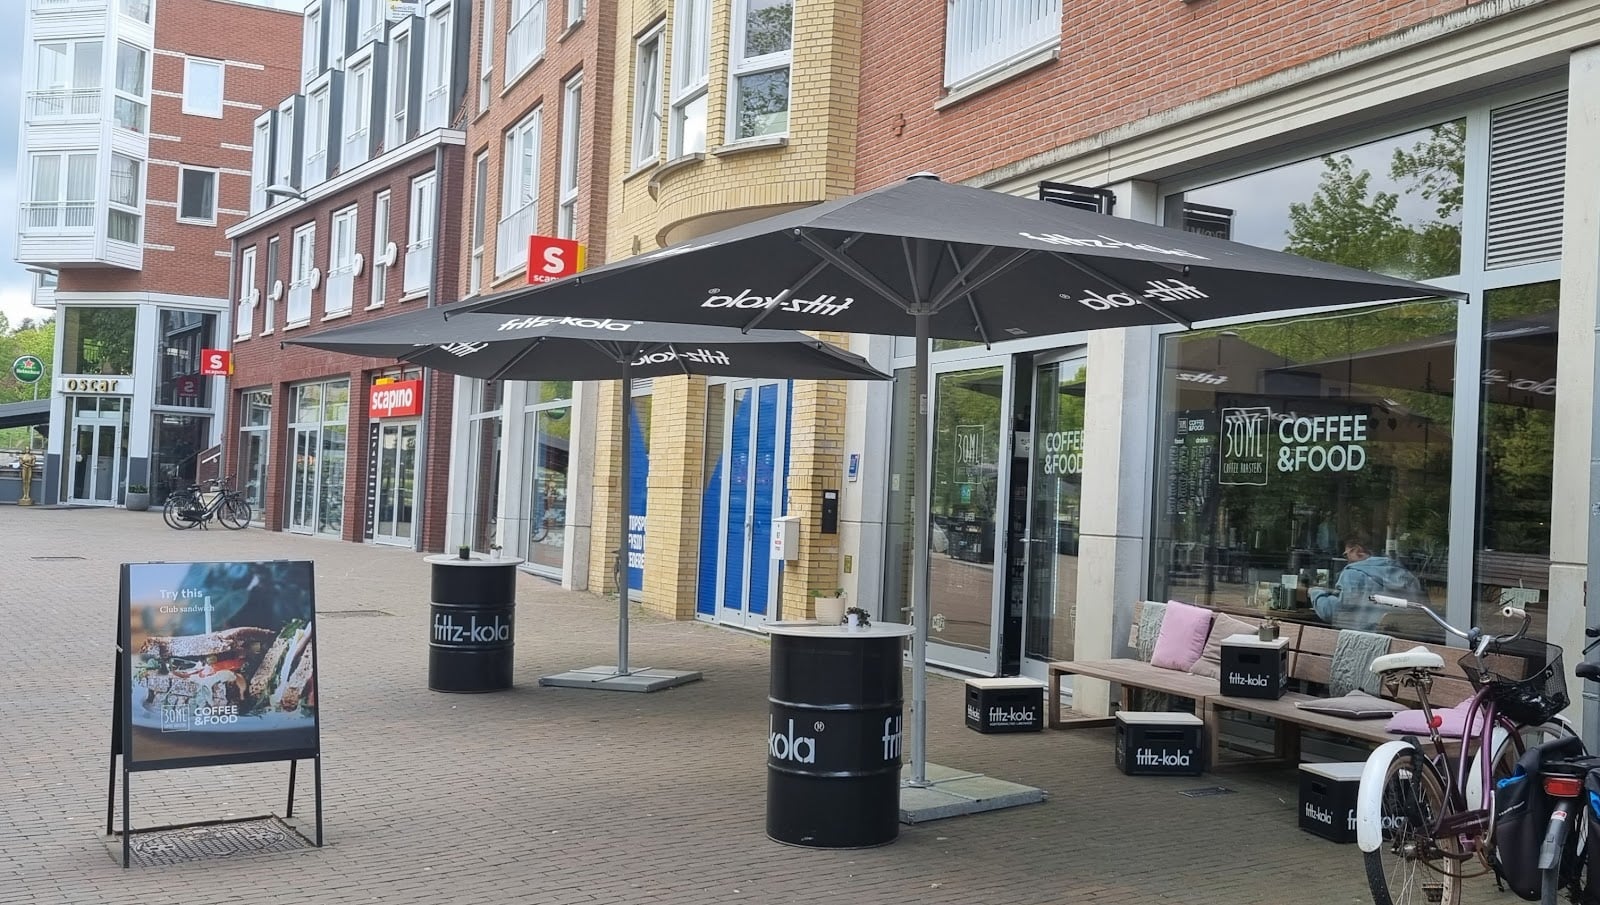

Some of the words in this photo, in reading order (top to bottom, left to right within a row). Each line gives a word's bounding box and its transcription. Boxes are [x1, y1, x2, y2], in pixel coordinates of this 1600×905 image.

[543, 246, 565, 274] S
[209, 354, 223, 370] S
[68, 379, 119, 392] oscar
[372, 388, 413, 417] scapino
[1279, 415, 1368, 443] COFFEE
[1044, 452, 1083, 474] &FOOD
[1277, 445, 1366, 472] &FOOD
[160, 589, 178, 600] Try
[181, 588, 203, 598] this
[160, 605, 178, 613] Club
[434, 613, 509, 642] fritz-kola
[1229, 671, 1267, 687] fritz-kola
[194, 705, 238, 717] COFFEE
[989, 706, 1033, 722] fritz-kola
[194, 714, 238, 726] &FOOD
[1136, 748, 1190, 766] fritz-kola
[1305, 802, 1332, 825] fritz-kola
